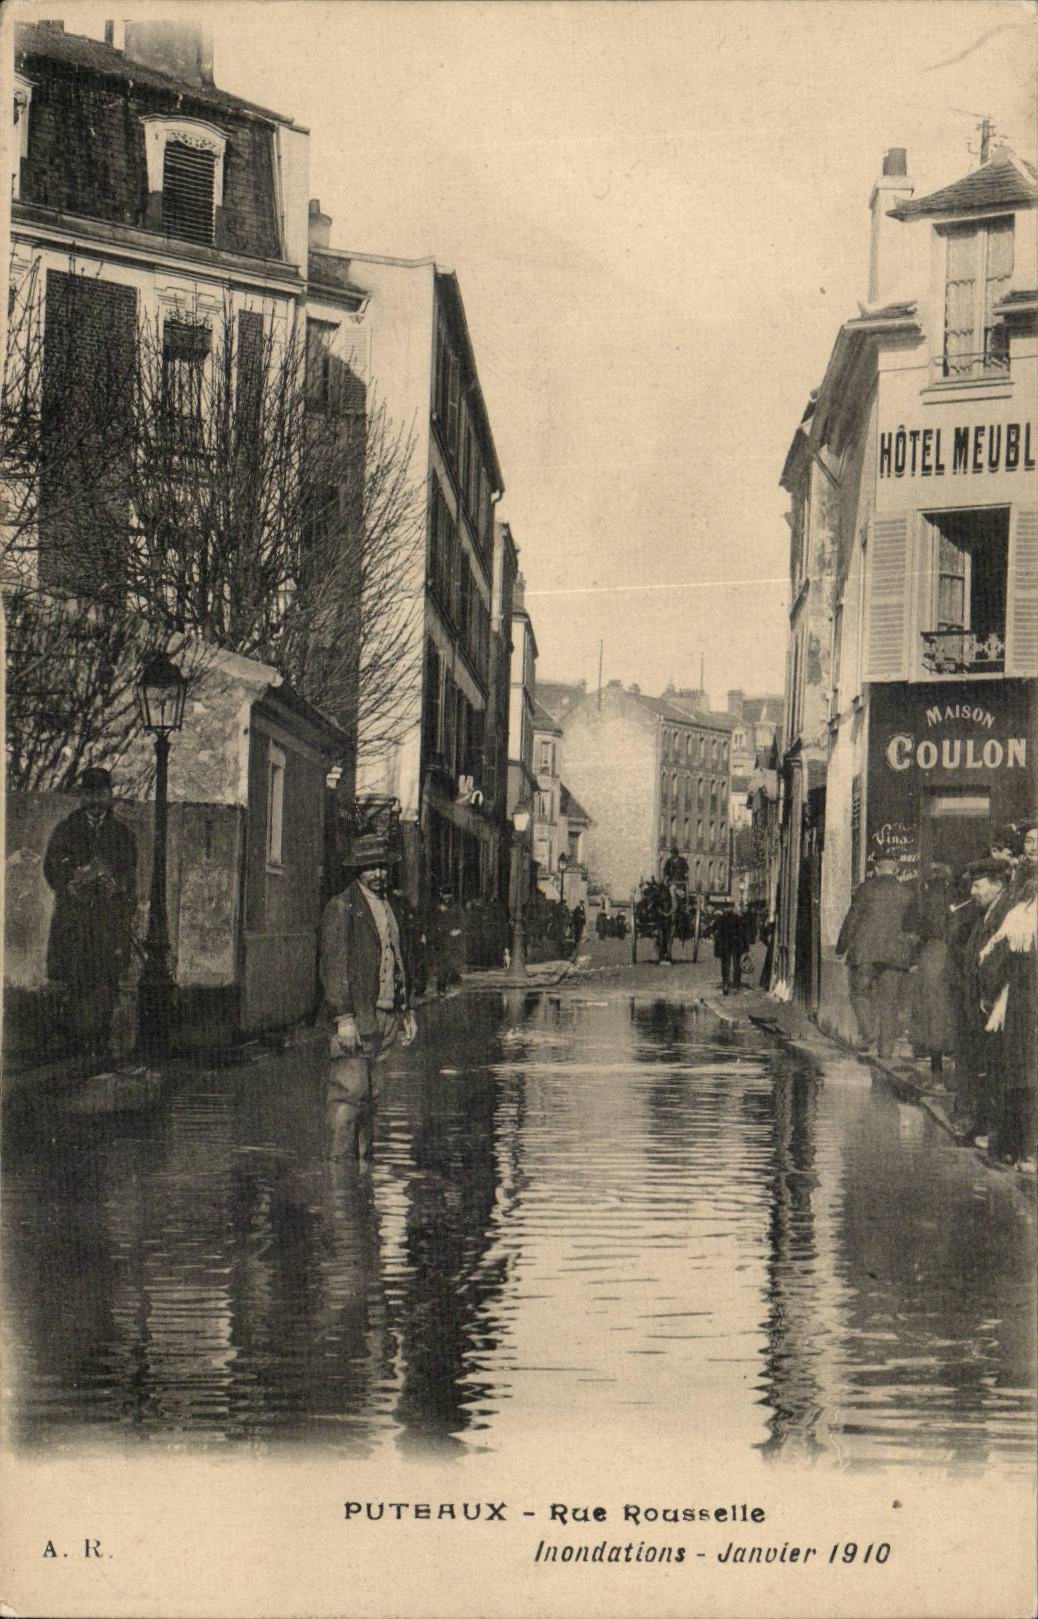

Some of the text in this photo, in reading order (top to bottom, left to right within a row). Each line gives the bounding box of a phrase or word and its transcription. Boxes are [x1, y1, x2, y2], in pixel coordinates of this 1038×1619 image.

[879, 422, 1036, 478] HÔTEL MEUBL
[925, 704, 996, 729] MAISON
[887, 734, 1026, 769] COULON
